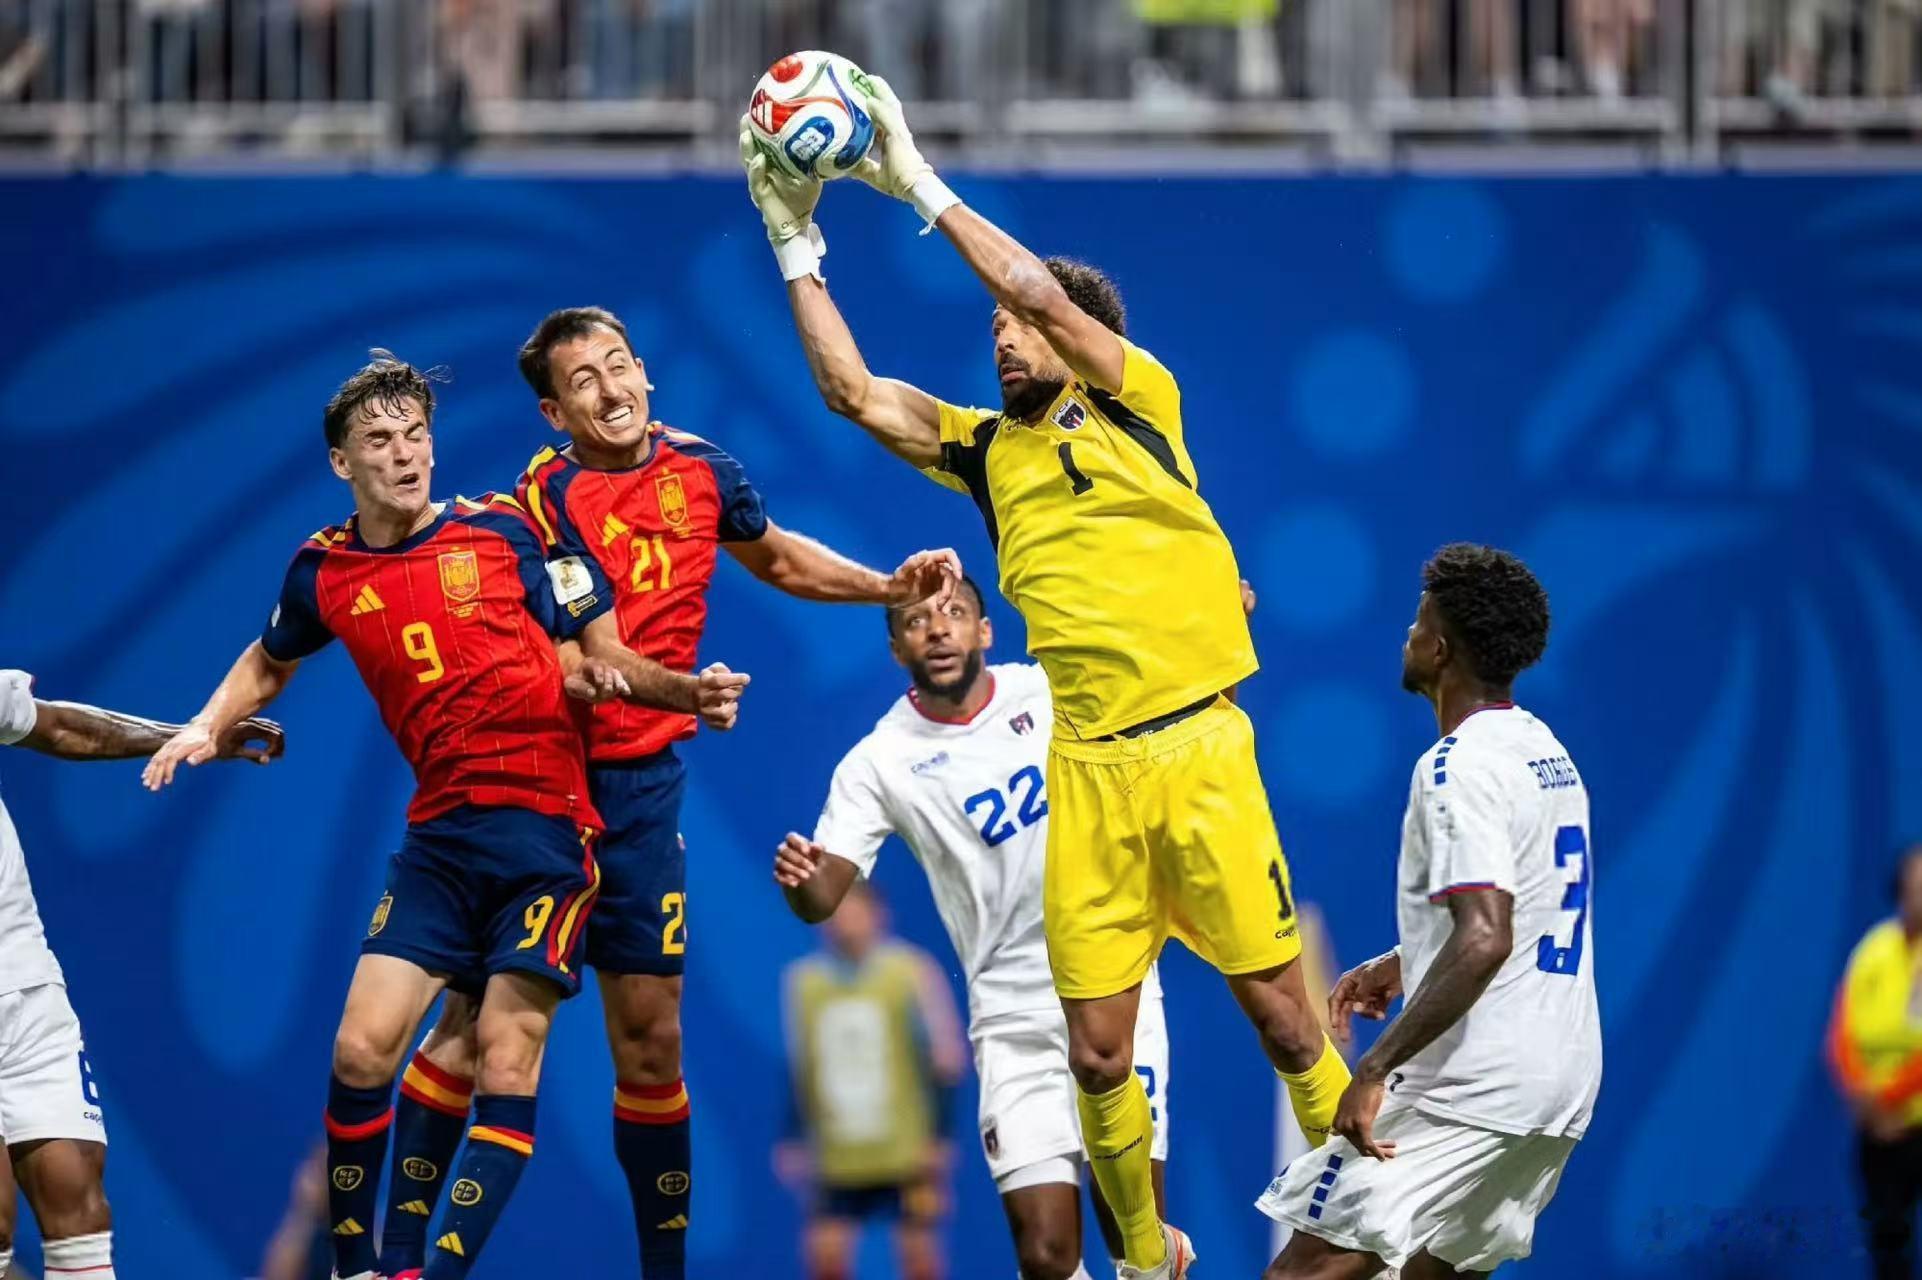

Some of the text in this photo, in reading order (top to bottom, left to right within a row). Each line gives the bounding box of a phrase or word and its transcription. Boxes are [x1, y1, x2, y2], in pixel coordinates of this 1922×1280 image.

[1058, 441, 1094, 496] 1
[630, 533, 672, 593] 21
[401, 621, 445, 683] 9
[964, 765, 1048, 848] 22
[1268, 859, 1291, 920] 1
[1536, 825, 1590, 976] 3
[515, 894, 554, 951] 9
[662, 893, 687, 955] 2
